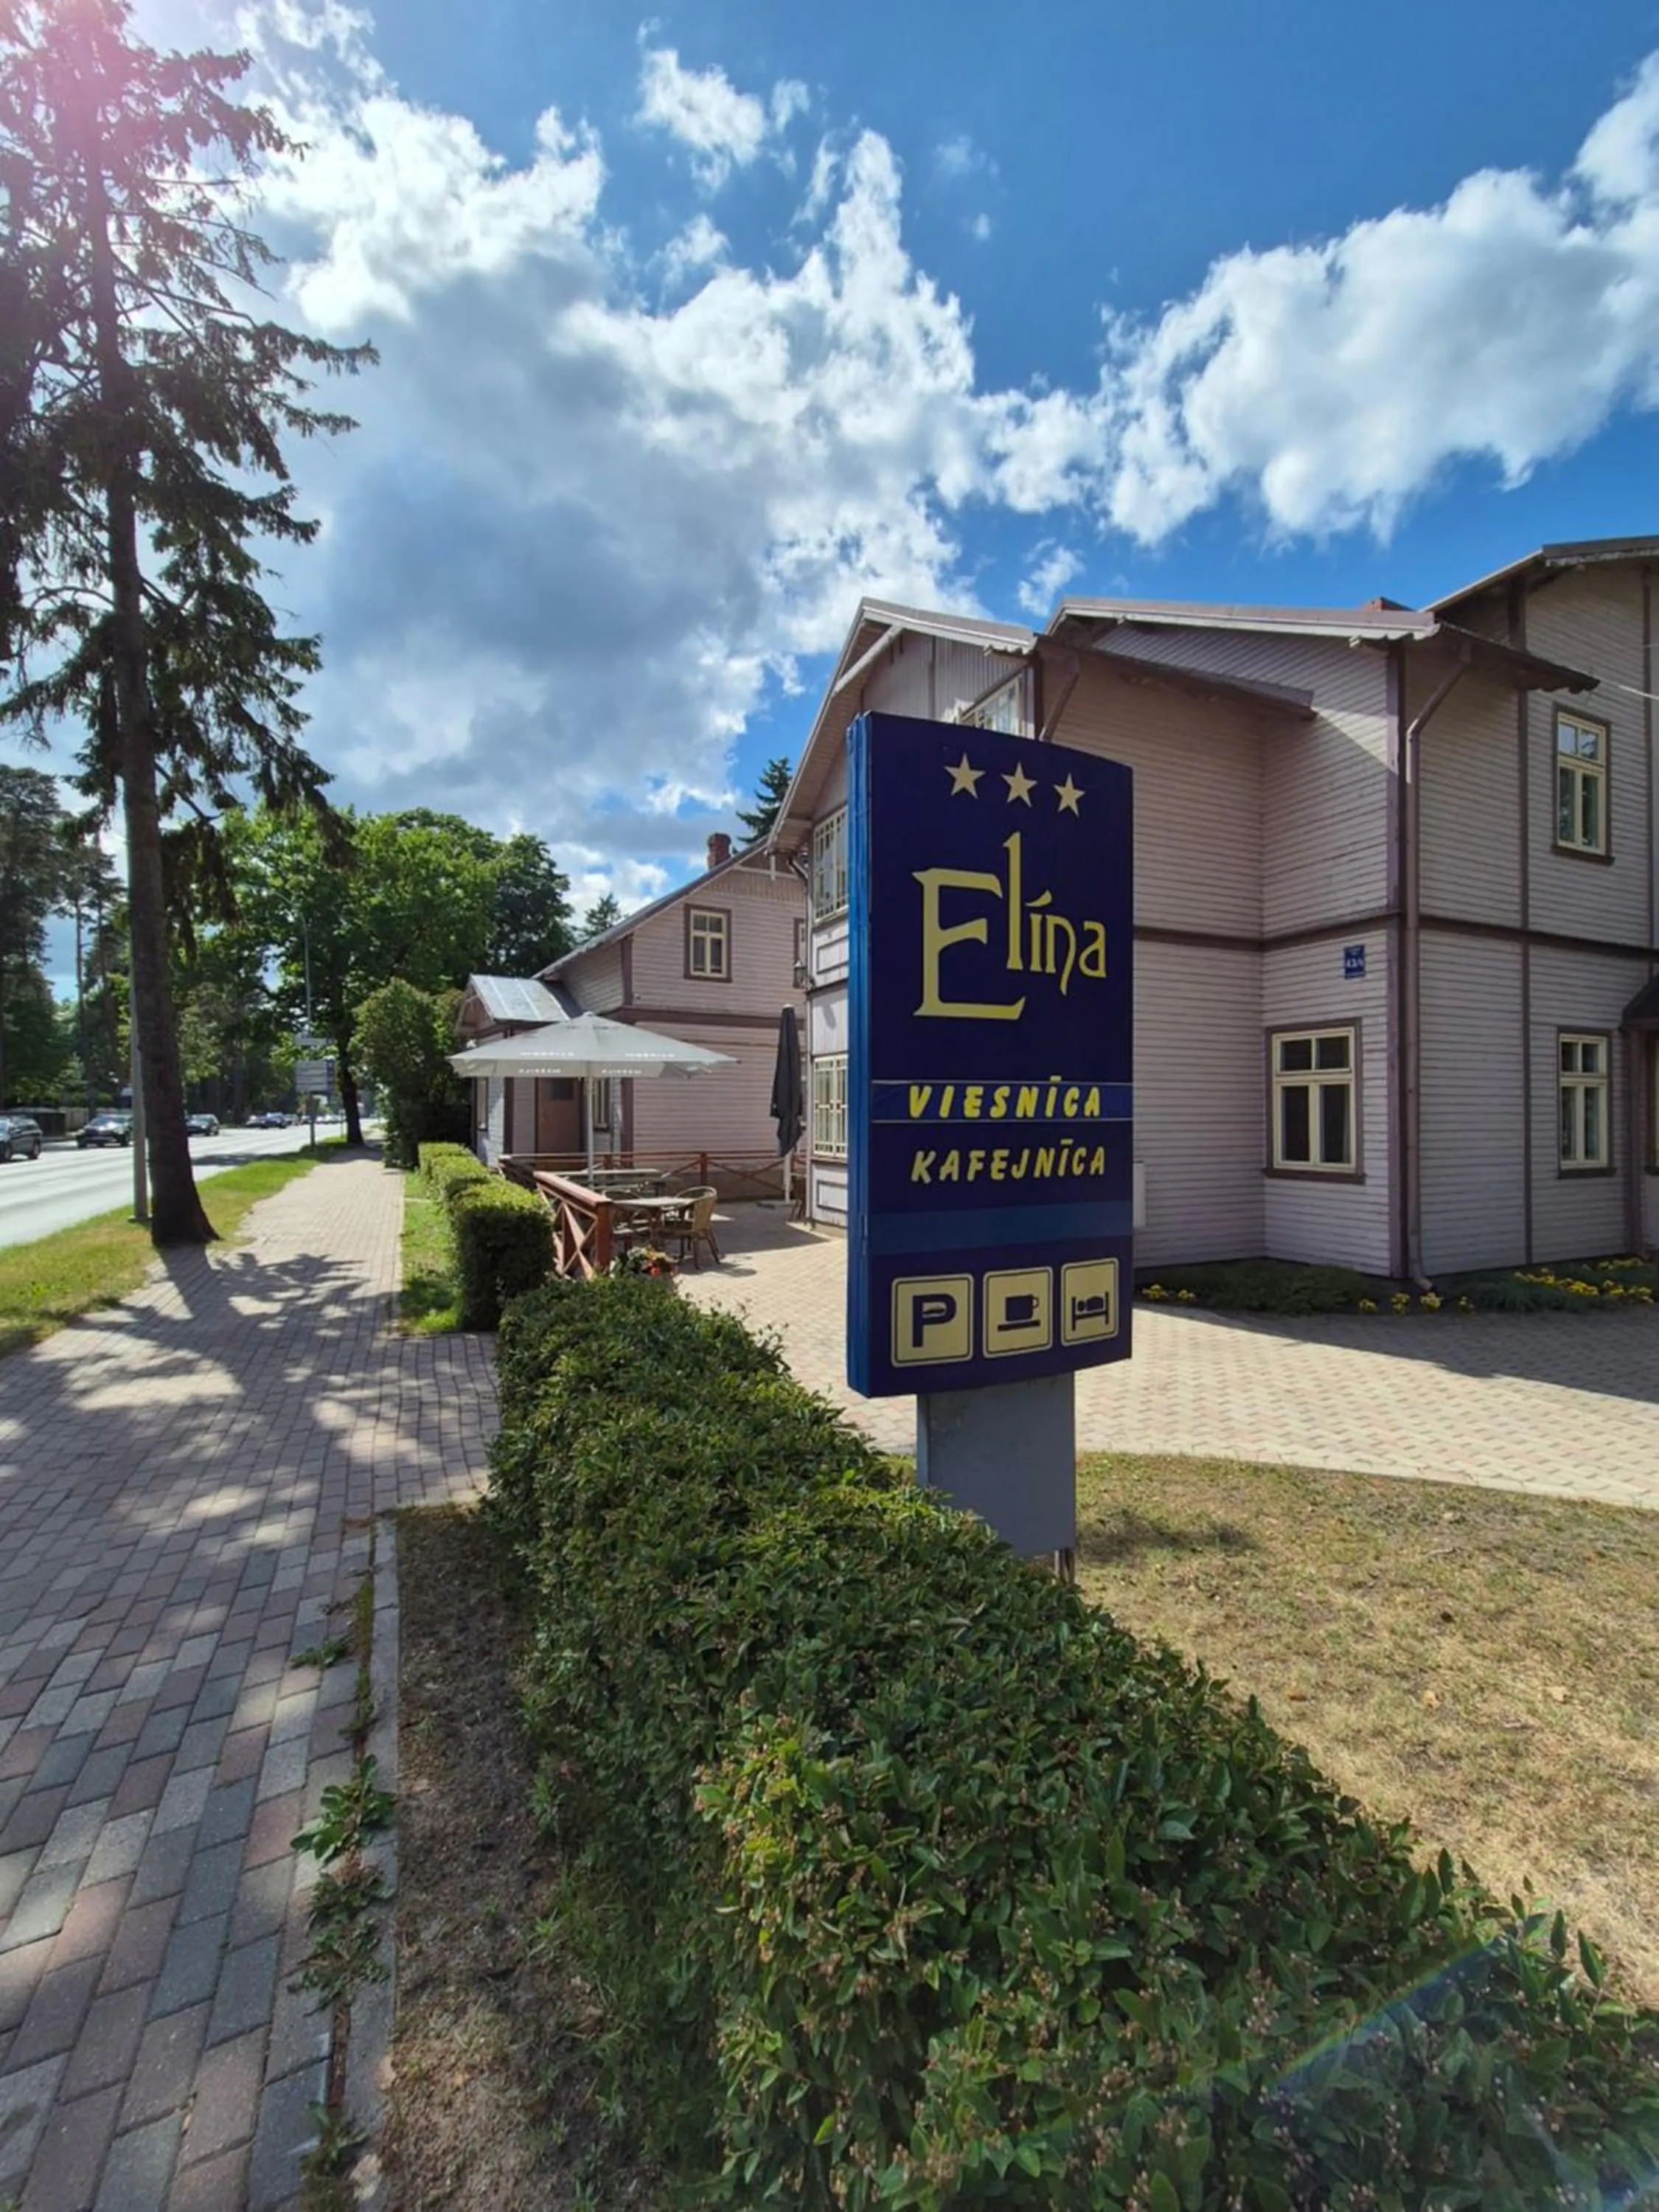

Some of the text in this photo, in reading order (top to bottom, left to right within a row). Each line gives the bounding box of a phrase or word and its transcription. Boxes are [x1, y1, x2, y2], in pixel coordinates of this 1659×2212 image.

[909, 1075, 1101, 1119] VIESNĪCA
[911, 1138, 1105, 1183] KAFEJNĪCA
[911, 1293, 957, 1347] P
